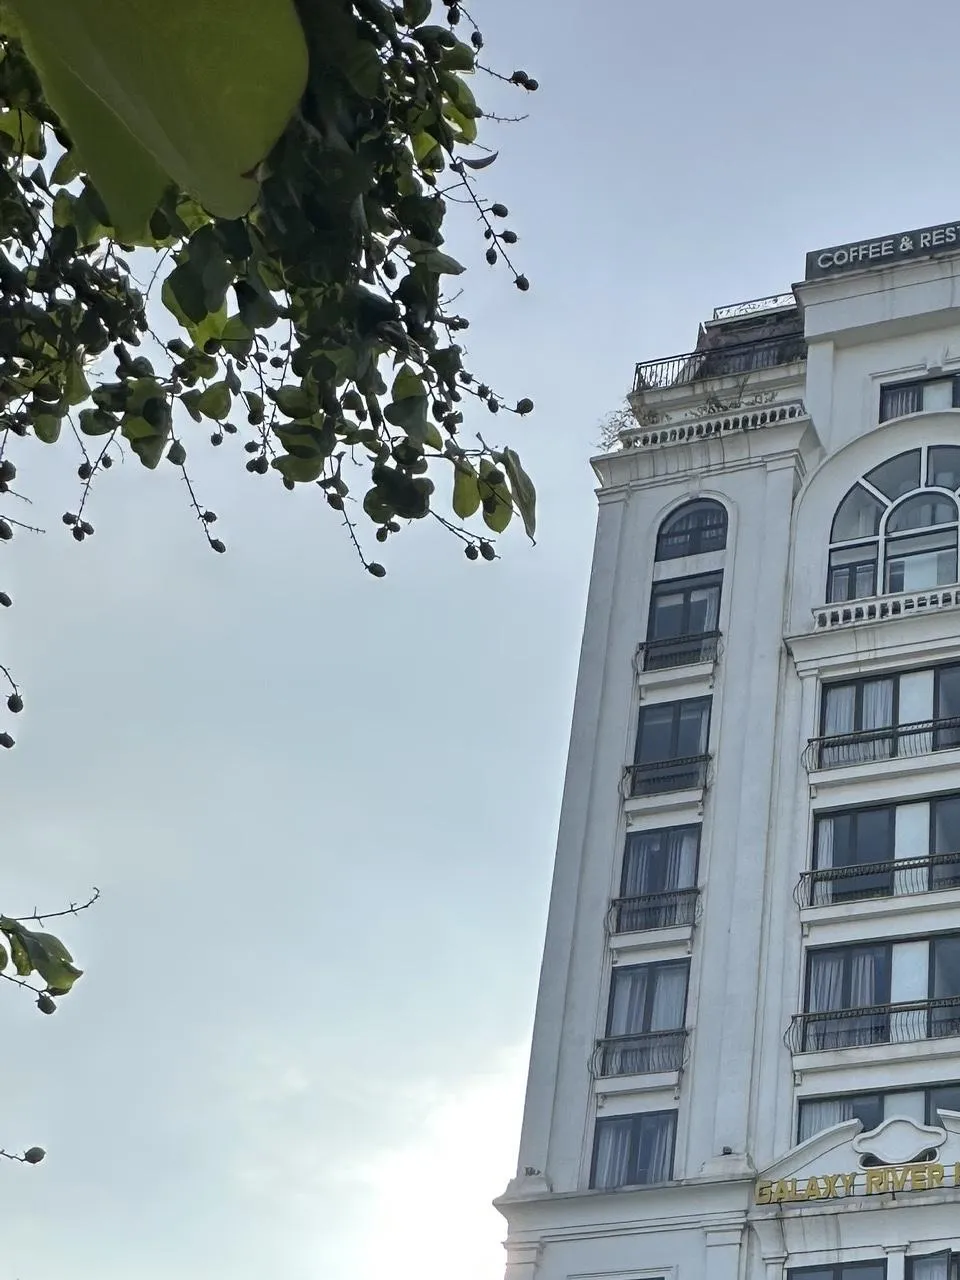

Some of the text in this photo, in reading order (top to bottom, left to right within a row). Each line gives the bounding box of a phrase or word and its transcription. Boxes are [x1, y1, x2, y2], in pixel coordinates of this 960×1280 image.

[817, 239, 895, 269] COFFEE
[900, 235, 914, 252] &
[755, 1171, 857, 1204] GALAXY
[866, 1164, 945, 1194] RIVER
